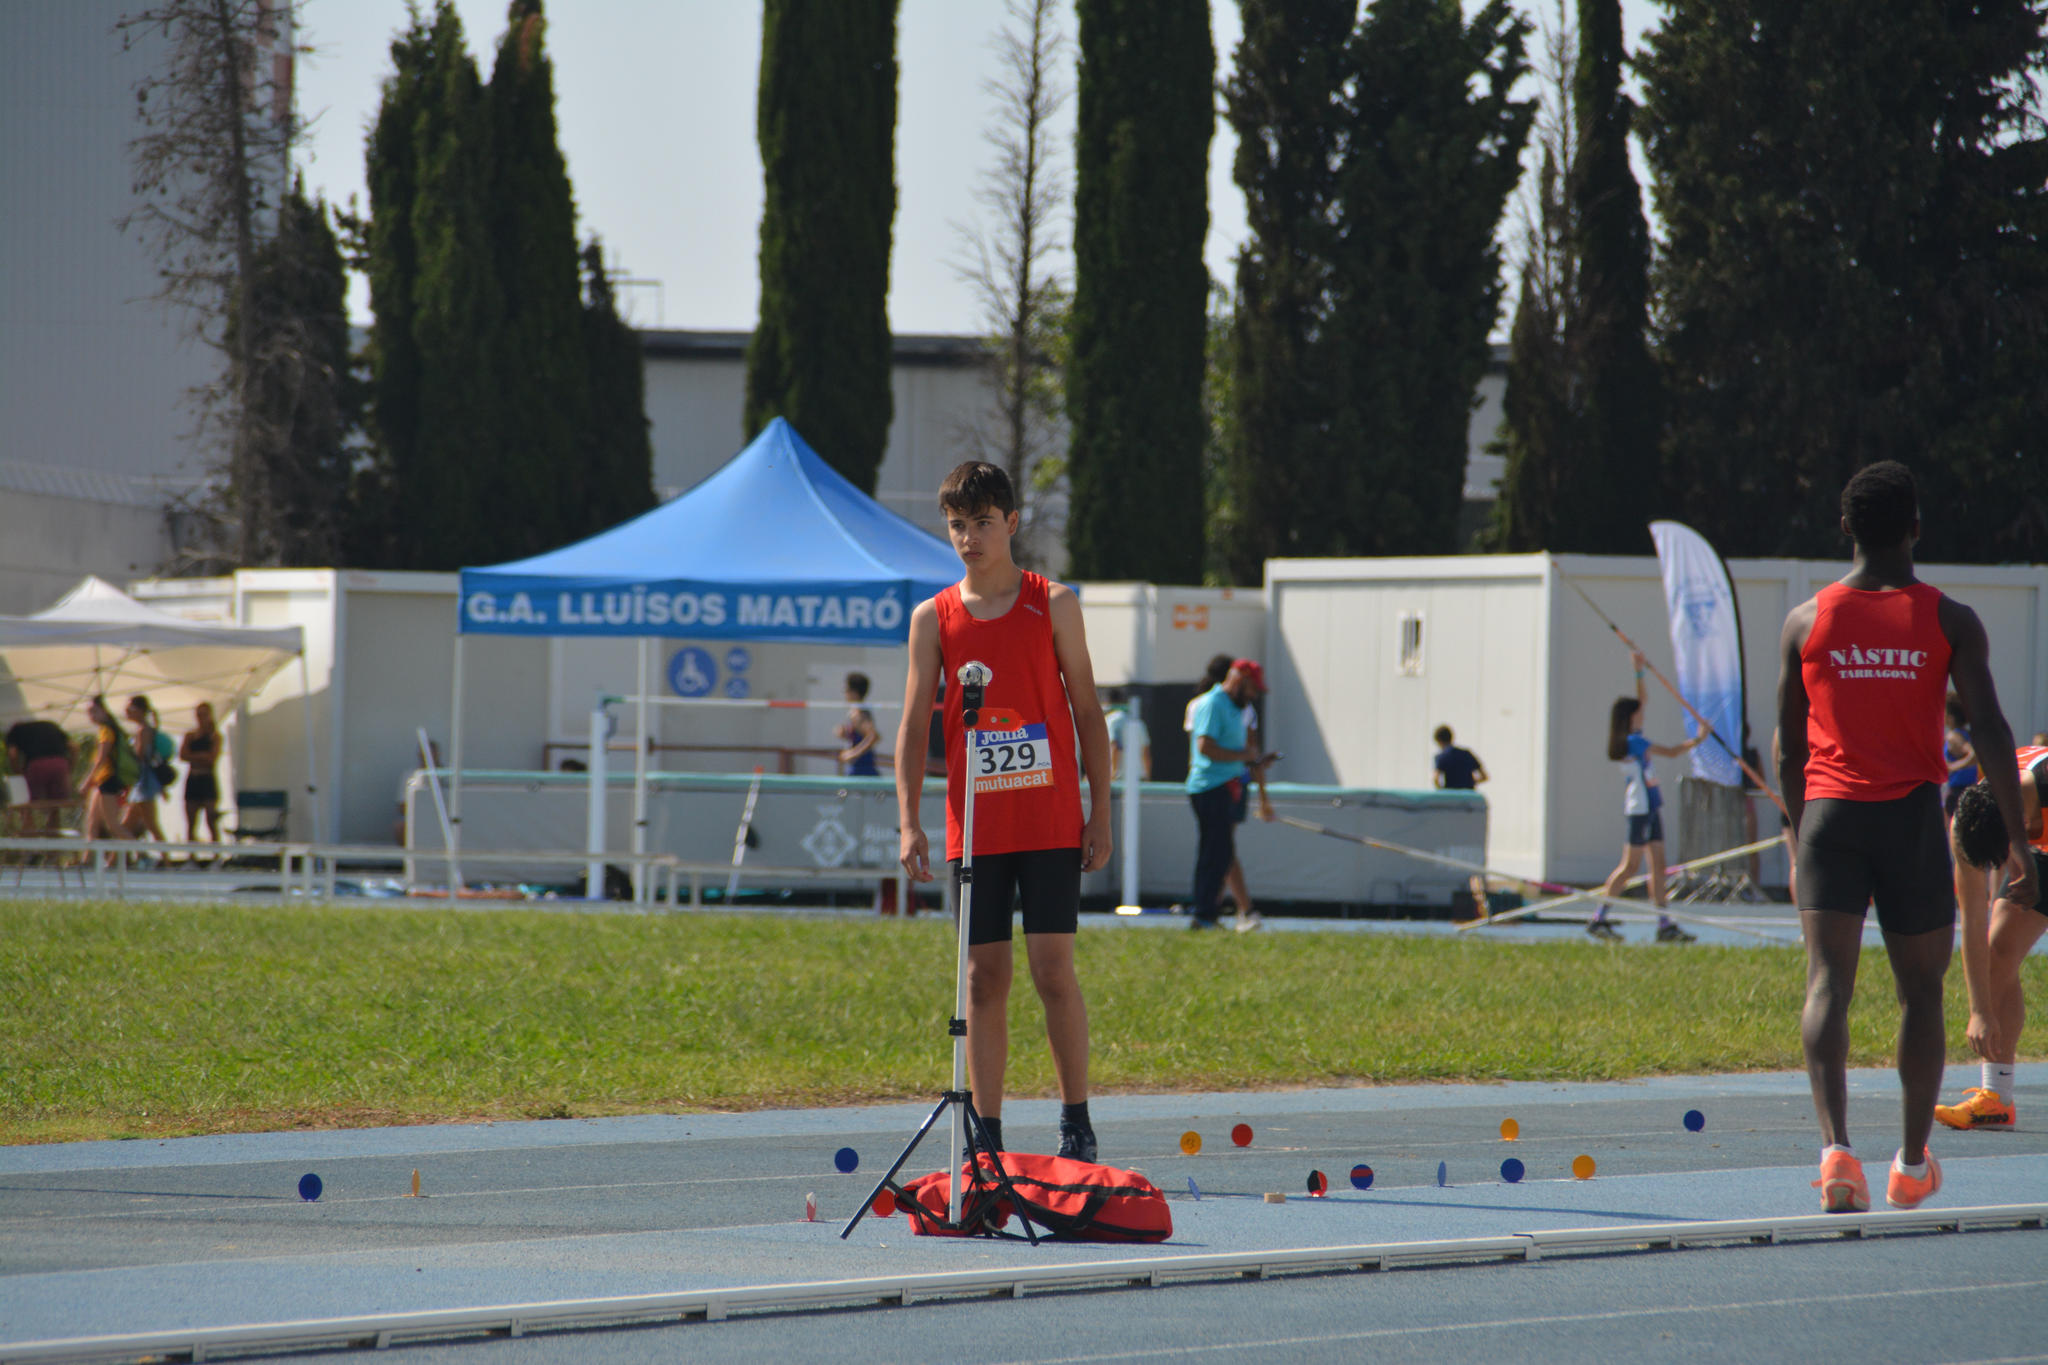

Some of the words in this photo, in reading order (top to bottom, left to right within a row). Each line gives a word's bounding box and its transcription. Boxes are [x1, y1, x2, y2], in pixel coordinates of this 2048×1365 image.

[466, 591, 548, 624] G.A.
[558, 585, 727, 625] LLUÏSOS
[737, 588, 904, 630] MATARÓ
[1828, 644, 1927, 667] NÀSTIC
[1838, 669, 1917, 680] TARRAGONA
[979, 743, 1035, 774] 329
[975, 771, 1048, 791] mutuacat
